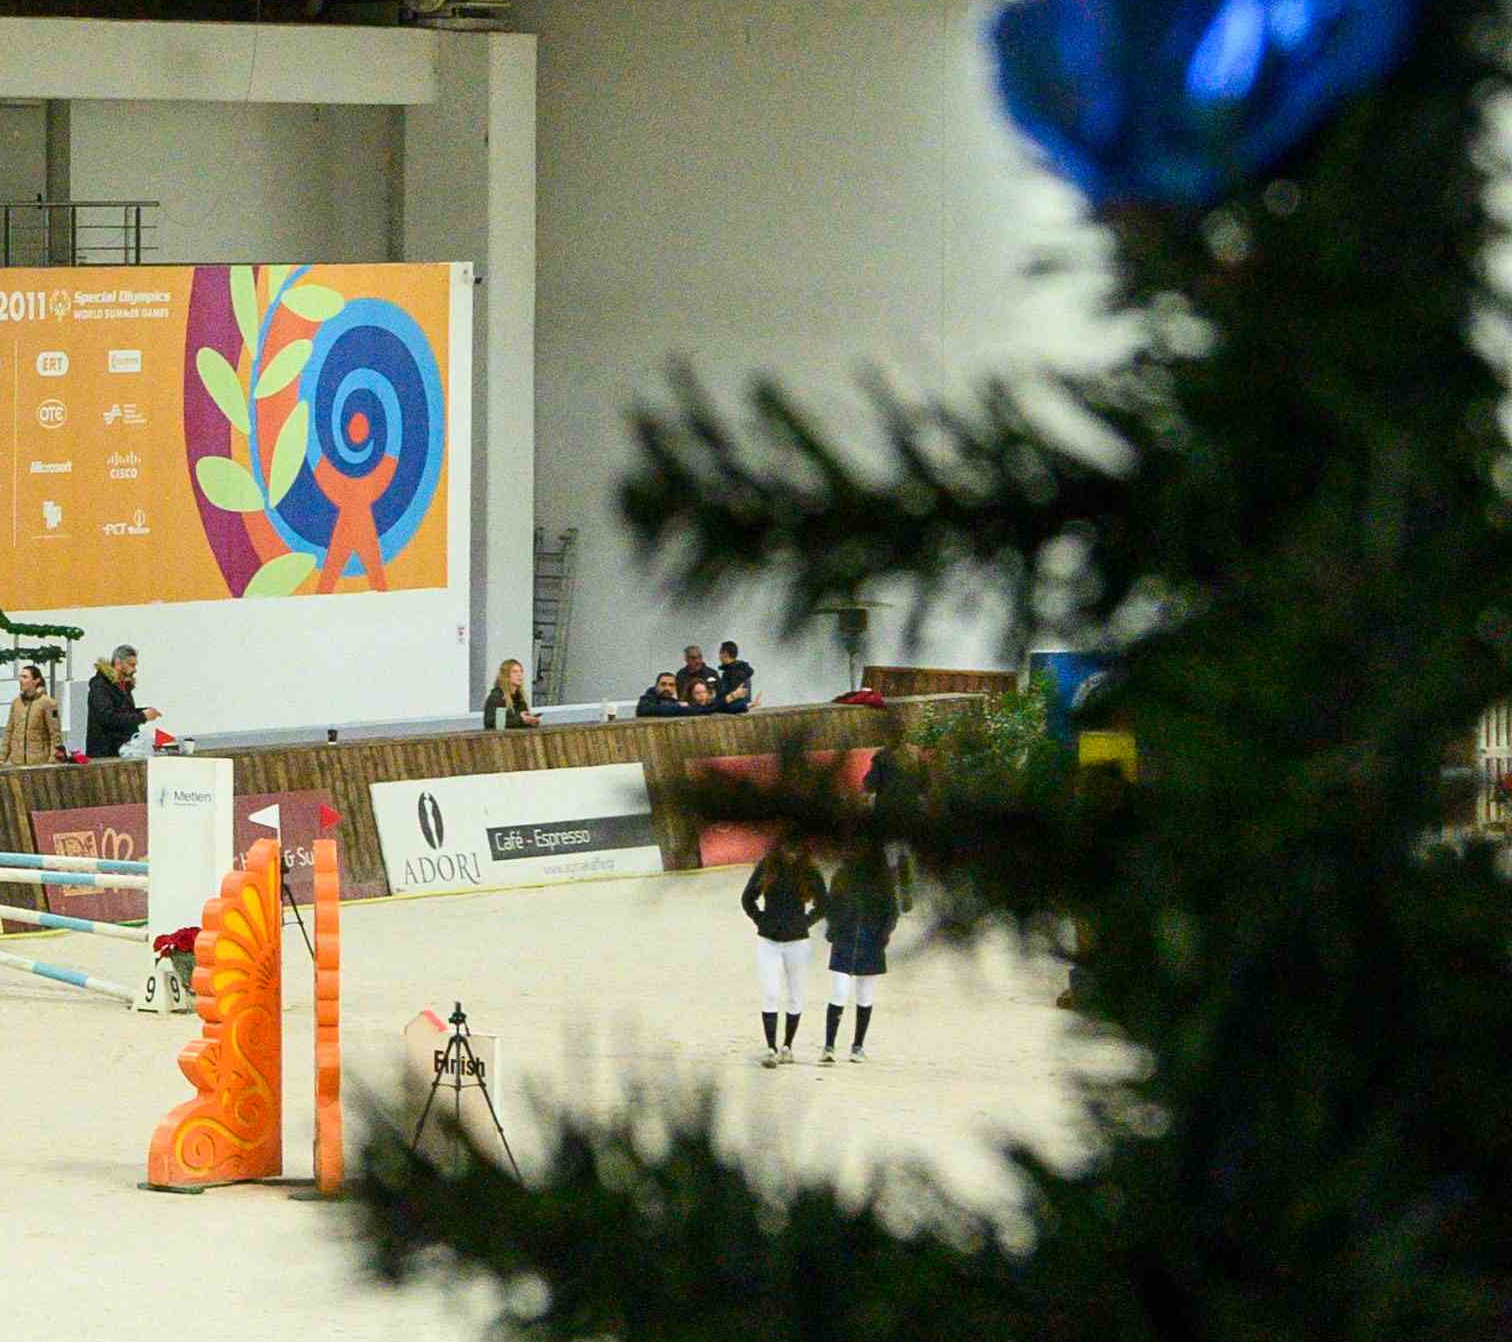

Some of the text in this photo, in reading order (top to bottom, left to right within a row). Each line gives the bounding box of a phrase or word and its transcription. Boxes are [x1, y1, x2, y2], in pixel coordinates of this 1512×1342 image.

[495, 831, 524, 852] Café
[534, 827, 591, 851] Espresso
[145, 976, 156, 1003] 9
[170, 975, 181, 1004] 9
[434, 1049, 486, 1078] Finish
